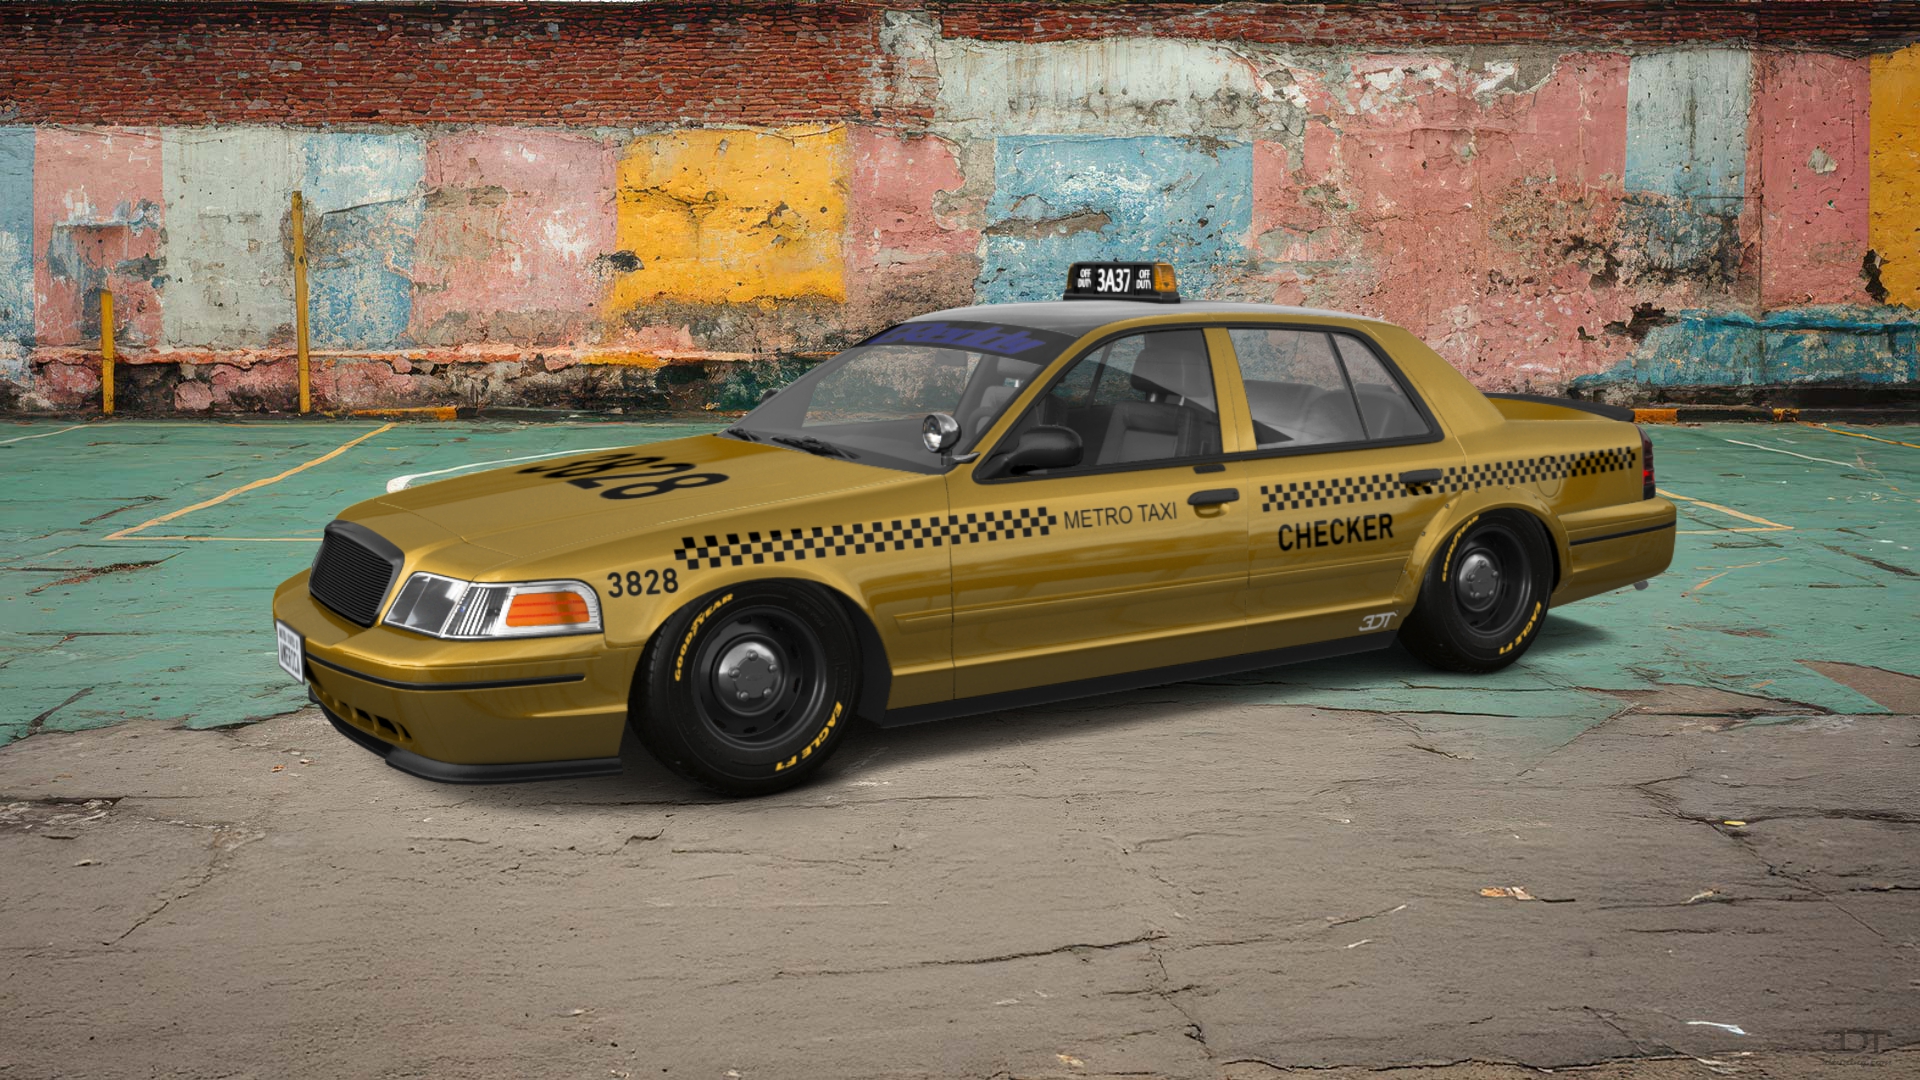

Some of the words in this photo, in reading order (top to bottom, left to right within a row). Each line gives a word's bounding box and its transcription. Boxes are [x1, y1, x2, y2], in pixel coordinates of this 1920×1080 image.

[1080, 268, 1092, 278] OFF
[1097, 268, 1131, 293] 3A37
[1139, 269, 1151, 279] OFF
[515, 453, 730, 500] 3828
[1063, 505, 1133, 530] METRO
[1137, 501, 1177, 522] TAXI
[1278, 513, 1394, 551] CHECKER
[607, 567, 679, 599] 3828
